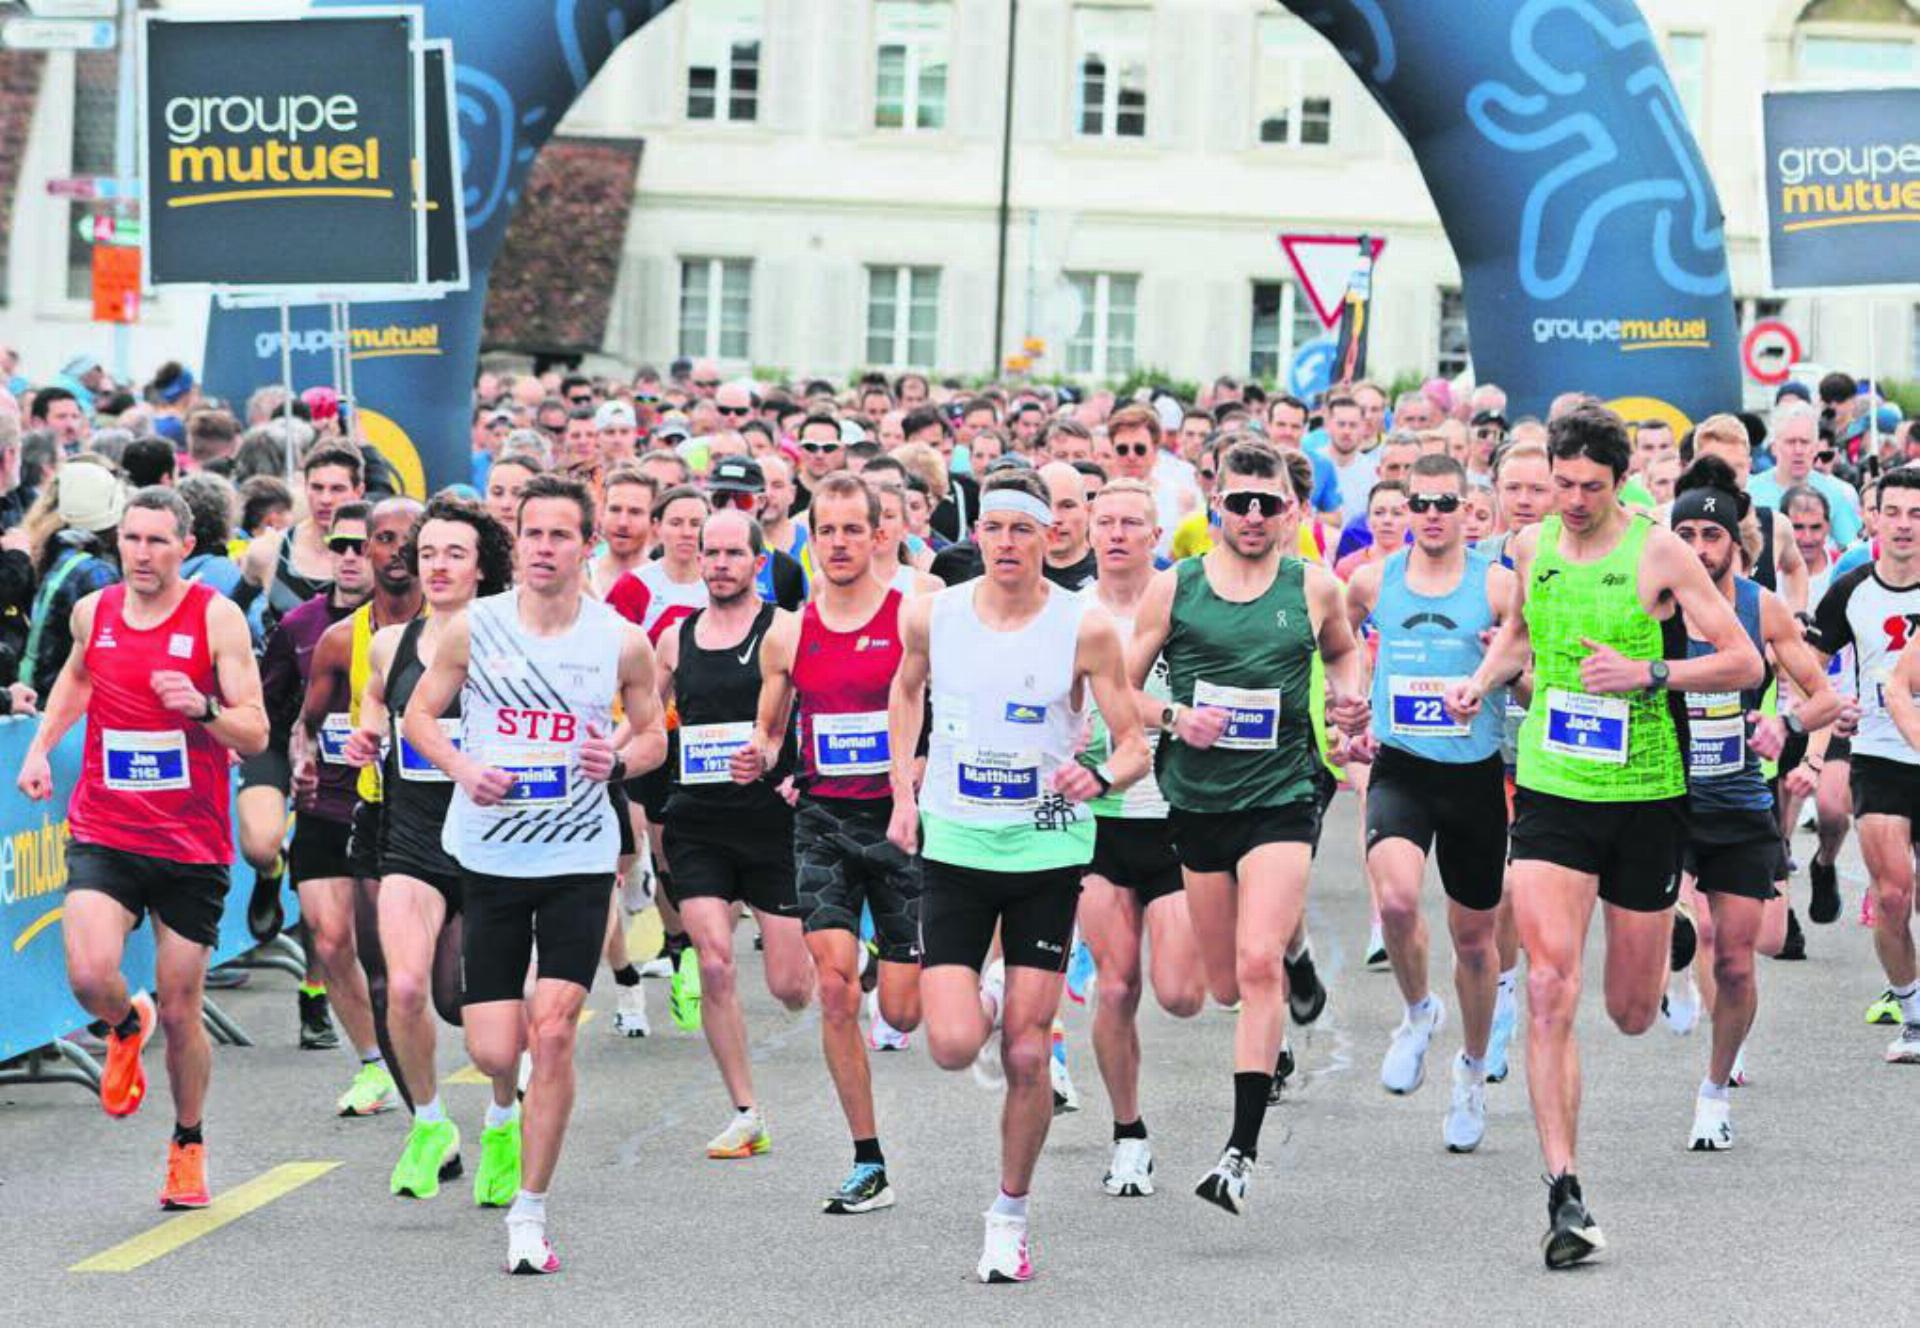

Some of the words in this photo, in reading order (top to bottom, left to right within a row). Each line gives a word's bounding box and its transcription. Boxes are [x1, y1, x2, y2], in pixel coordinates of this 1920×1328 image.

[165, 94, 358, 142] groupe
[168, 138, 380, 183] mutuel
[1778, 144, 1920, 184] groupe
[1783, 179, 1920, 213] mutue
[496, 708, 577, 742] STB
[1414, 701, 1442, 722] 22
[521, 785, 532, 797] 3
[964, 766, 1032, 784] Matthias
[993, 785, 1003, 797] 2
